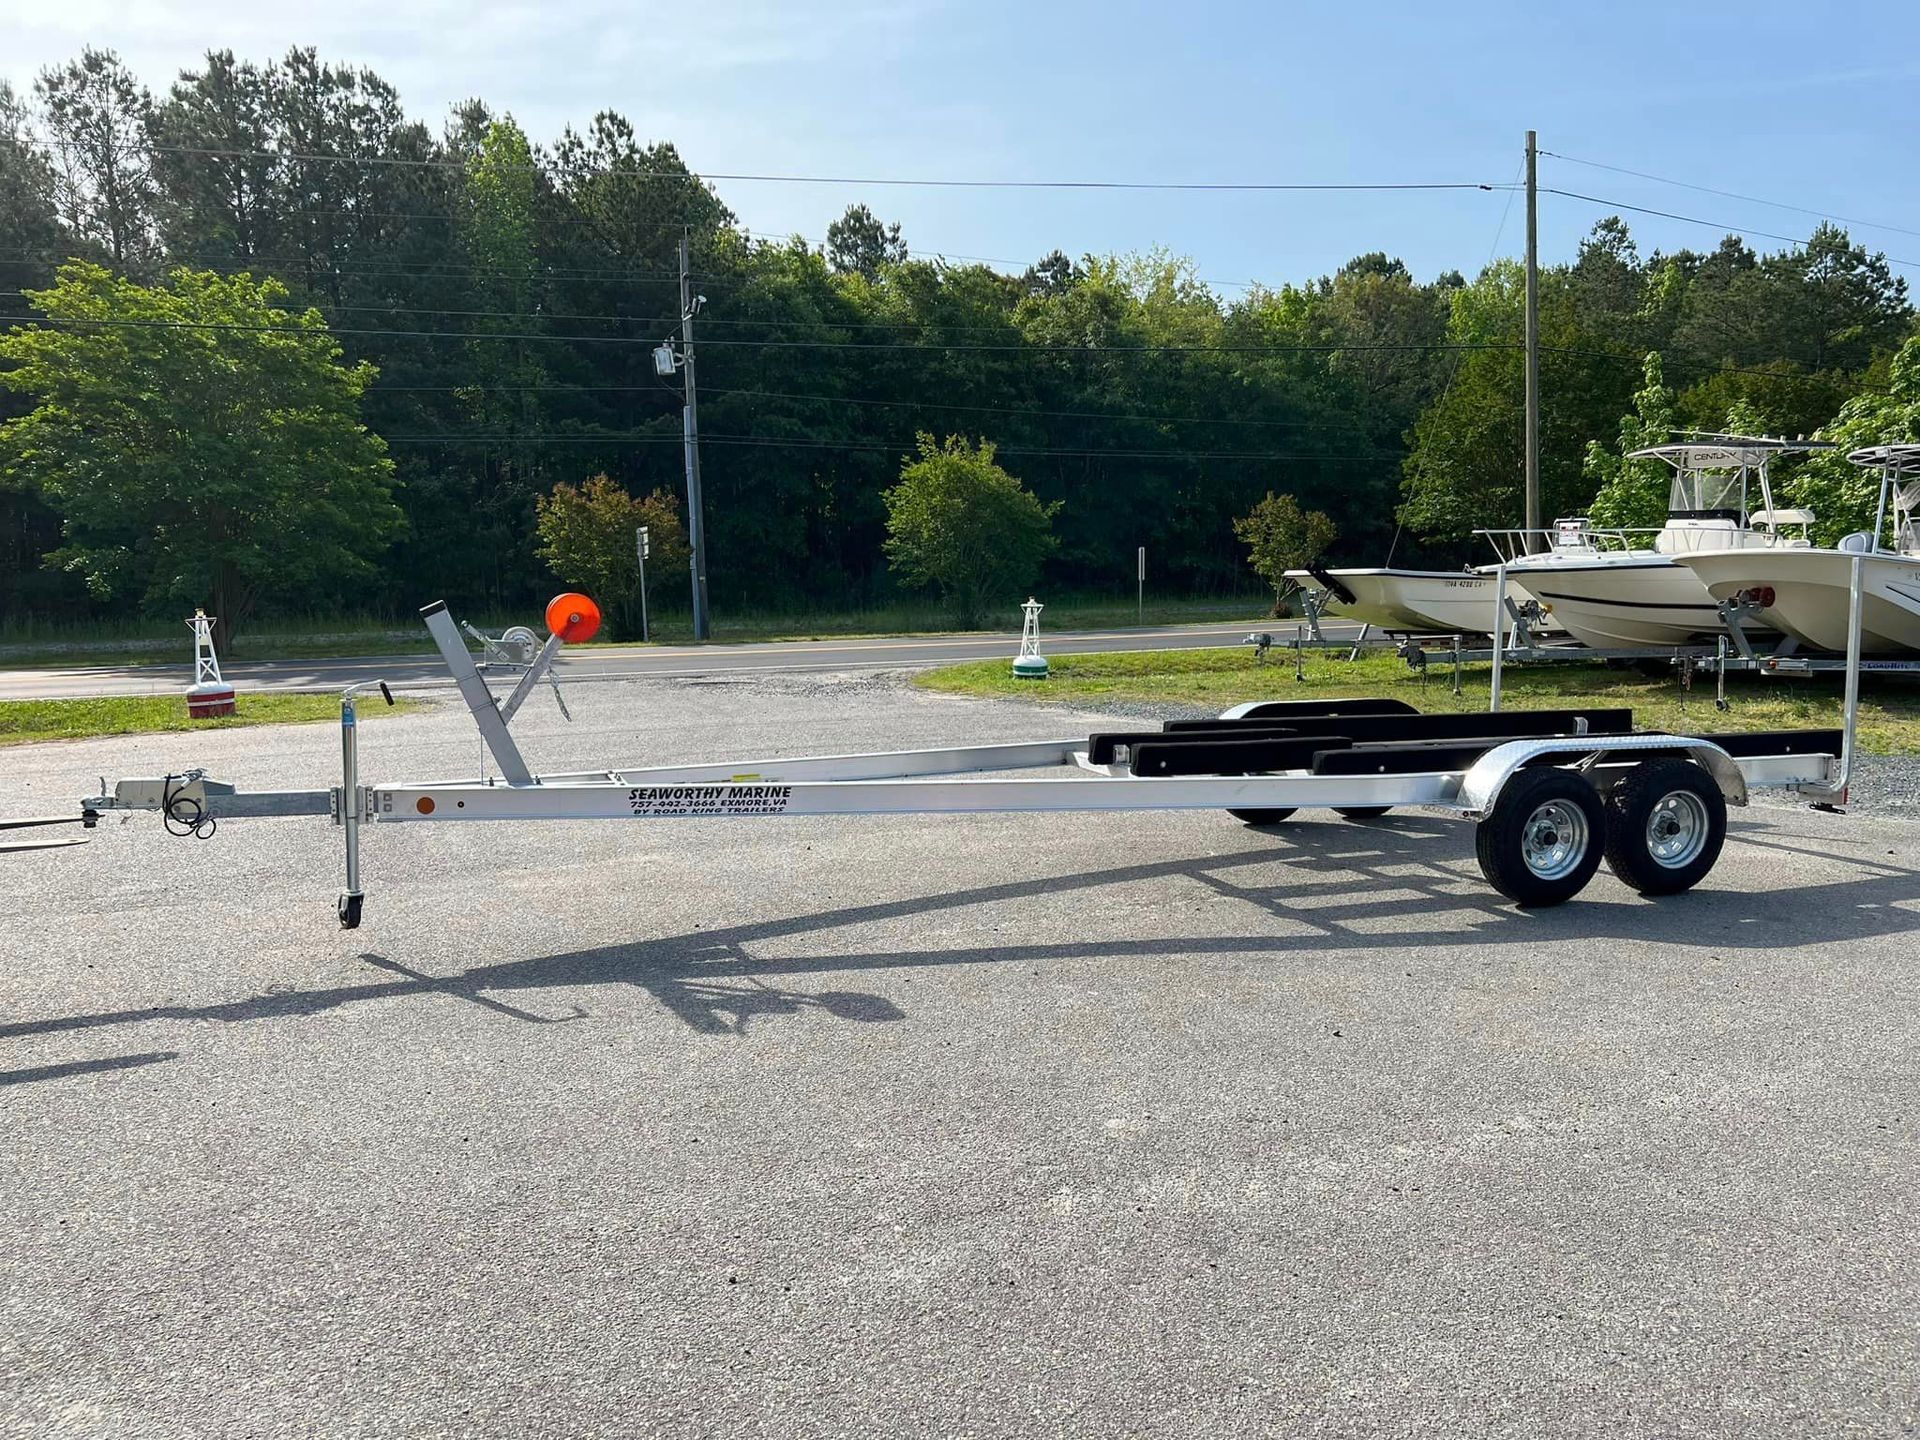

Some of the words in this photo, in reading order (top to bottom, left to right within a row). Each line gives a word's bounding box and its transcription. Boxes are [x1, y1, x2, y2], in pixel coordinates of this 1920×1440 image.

[628, 787, 724, 801] SEAWORTHY
[728, 786, 792, 800] MARINE
[630, 799, 716, 808] 757-442-3666
[727, 806, 786, 814] TRAILERS
